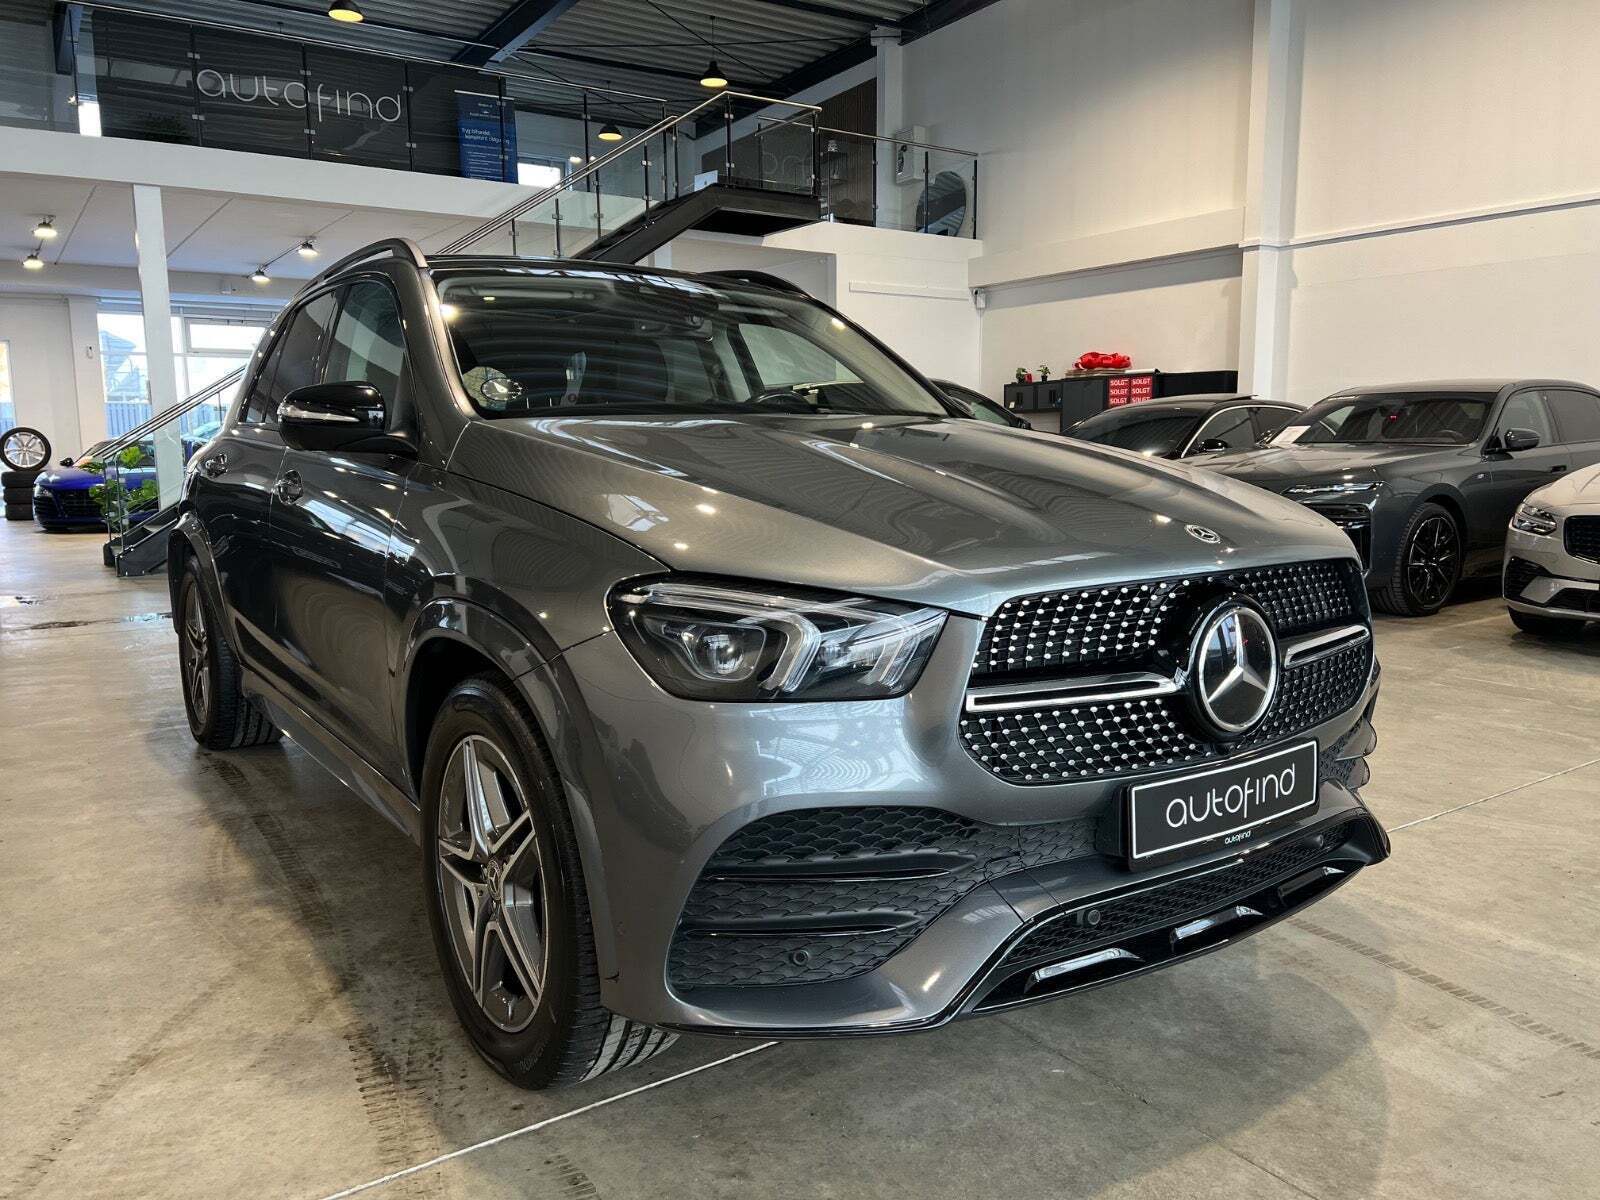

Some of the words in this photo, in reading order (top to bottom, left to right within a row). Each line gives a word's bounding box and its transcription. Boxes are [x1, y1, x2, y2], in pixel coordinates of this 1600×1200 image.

[197, 69, 401, 122] autofind
[1166, 763, 1295, 828] autofind
[1224, 830, 1252, 844] autofind
